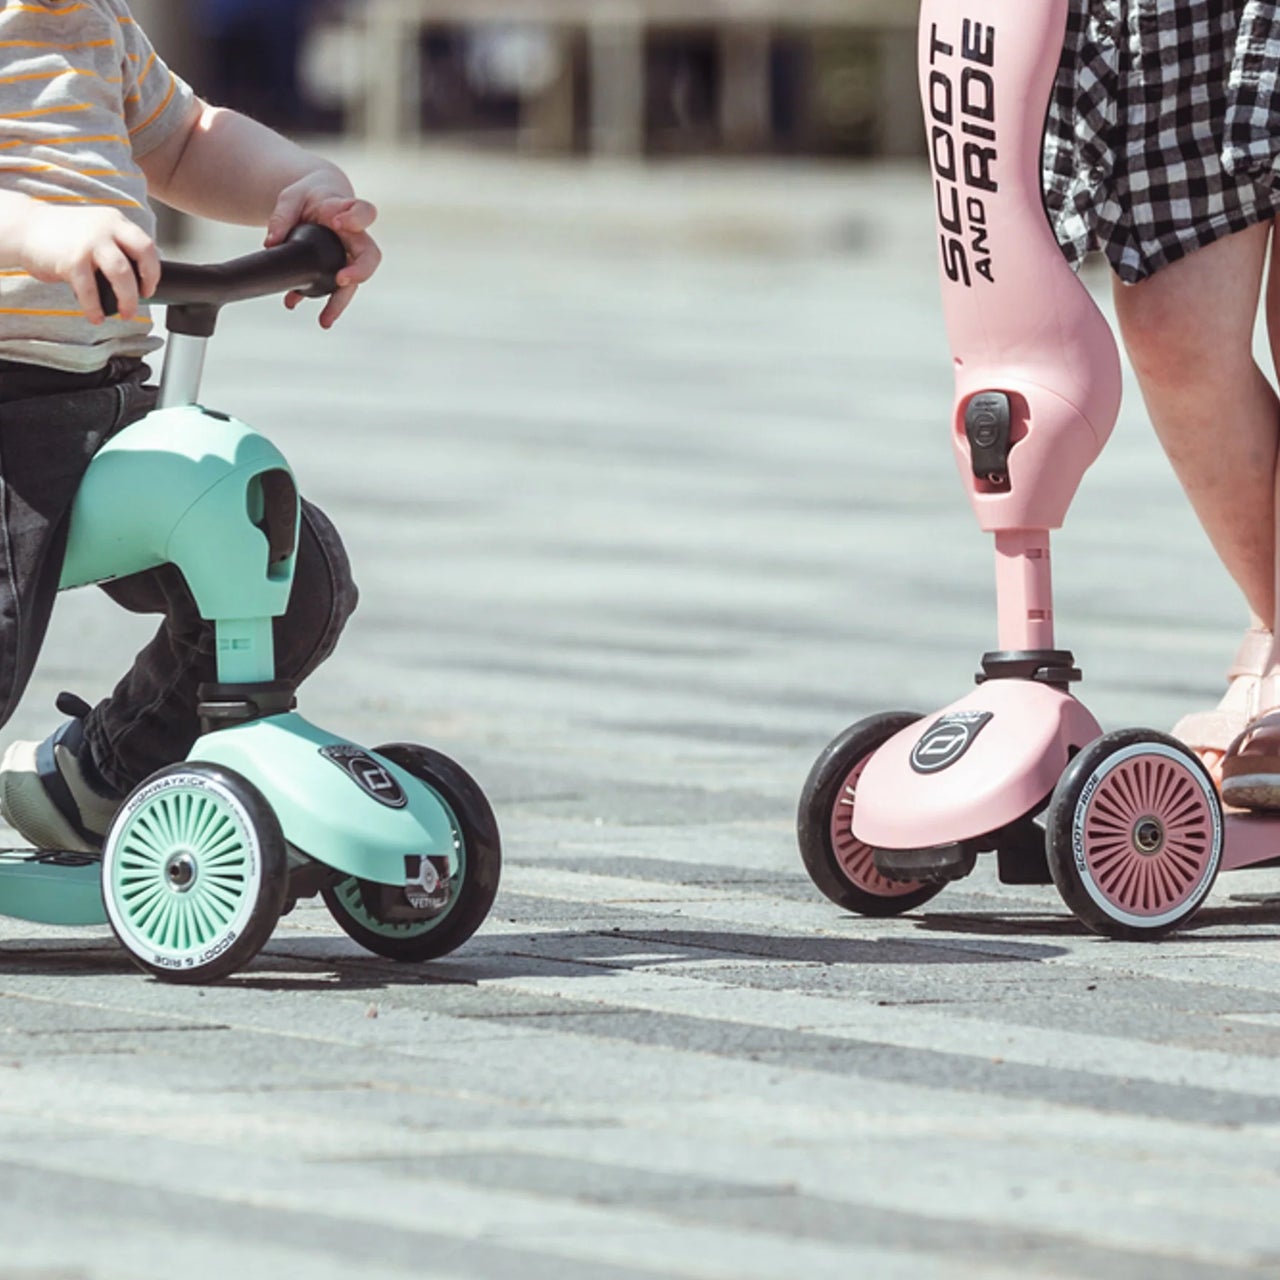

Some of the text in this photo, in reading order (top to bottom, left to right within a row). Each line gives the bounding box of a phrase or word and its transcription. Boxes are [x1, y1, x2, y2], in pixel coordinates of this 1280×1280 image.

[929, 22, 972, 288] SCOOT
[961, 18, 998, 283] AND RIDE
[127, 776, 206, 812] HIGHWAYKICK
[154, 955, 182, 968] RIDE
[199, 930, 236, 963] SCOOT
